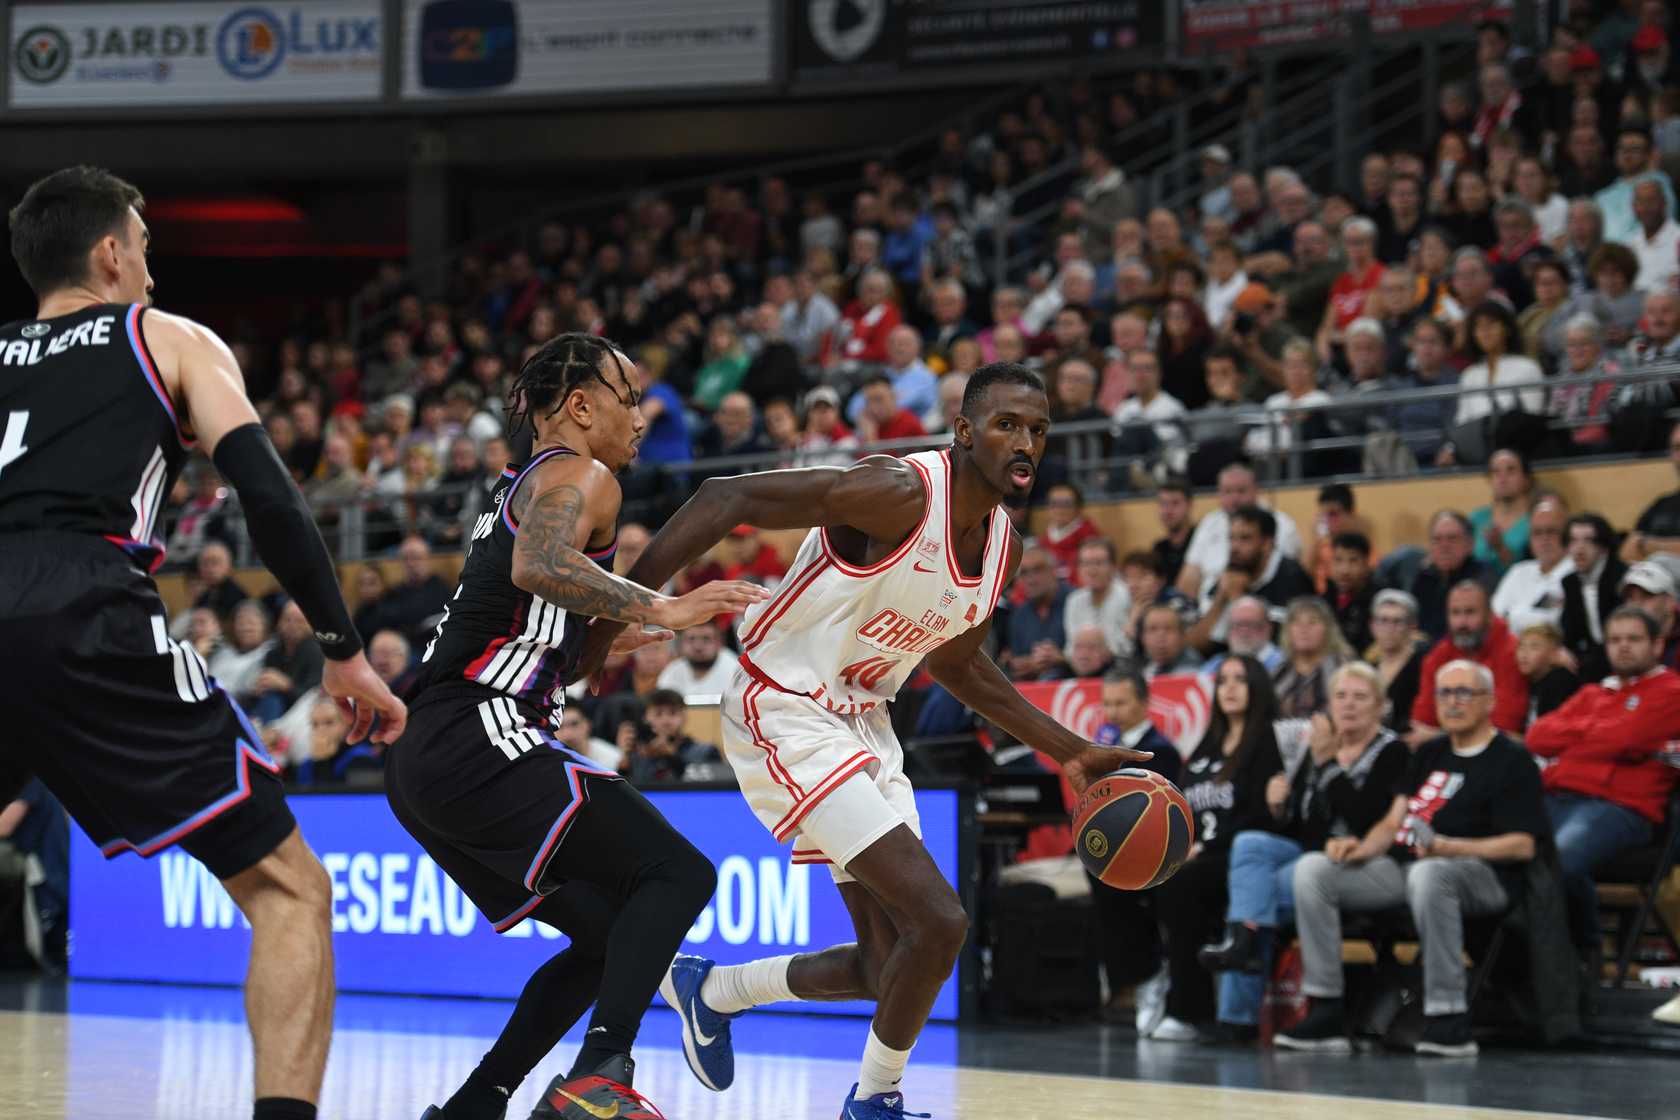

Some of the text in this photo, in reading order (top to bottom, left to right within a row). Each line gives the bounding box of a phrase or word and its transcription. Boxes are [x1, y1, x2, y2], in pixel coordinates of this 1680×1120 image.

[80, 25, 210, 59] JARDI
[856, 609, 949, 653] CHALO
[920, 608, 950, 632] ELAN
